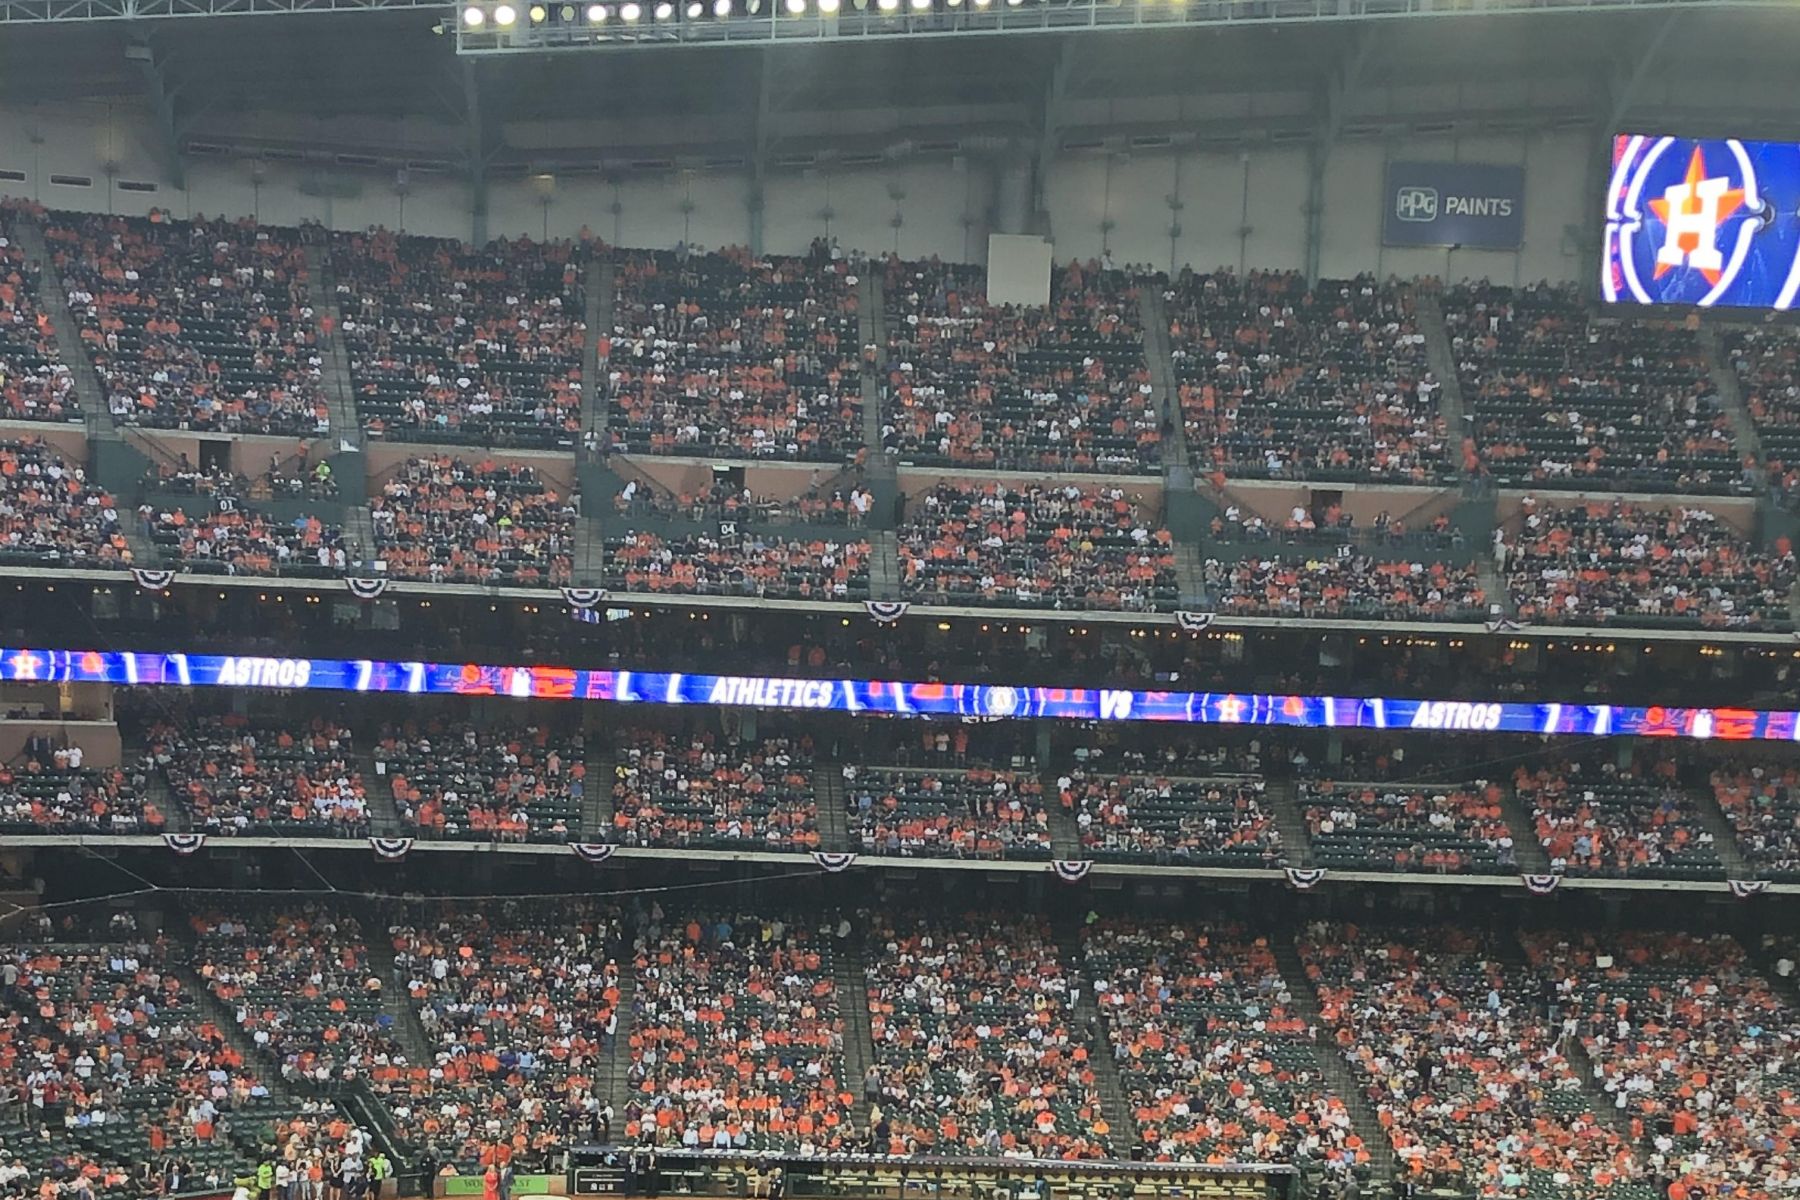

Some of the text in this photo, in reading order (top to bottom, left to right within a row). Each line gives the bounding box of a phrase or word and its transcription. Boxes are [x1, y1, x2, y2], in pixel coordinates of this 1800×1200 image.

[1400, 191, 1512, 217] PPG PAINTS
[1657, 176, 1731, 270] H
[220, 500, 234, 511] 01
[721, 523, 735, 535] 04
[217, 656, 312, 687] ASTROS
[708, 676, 834, 708] ATHLETICS
[1099, 689, 1134, 720] VS
[1410, 700, 1503, 730] ASTROS
